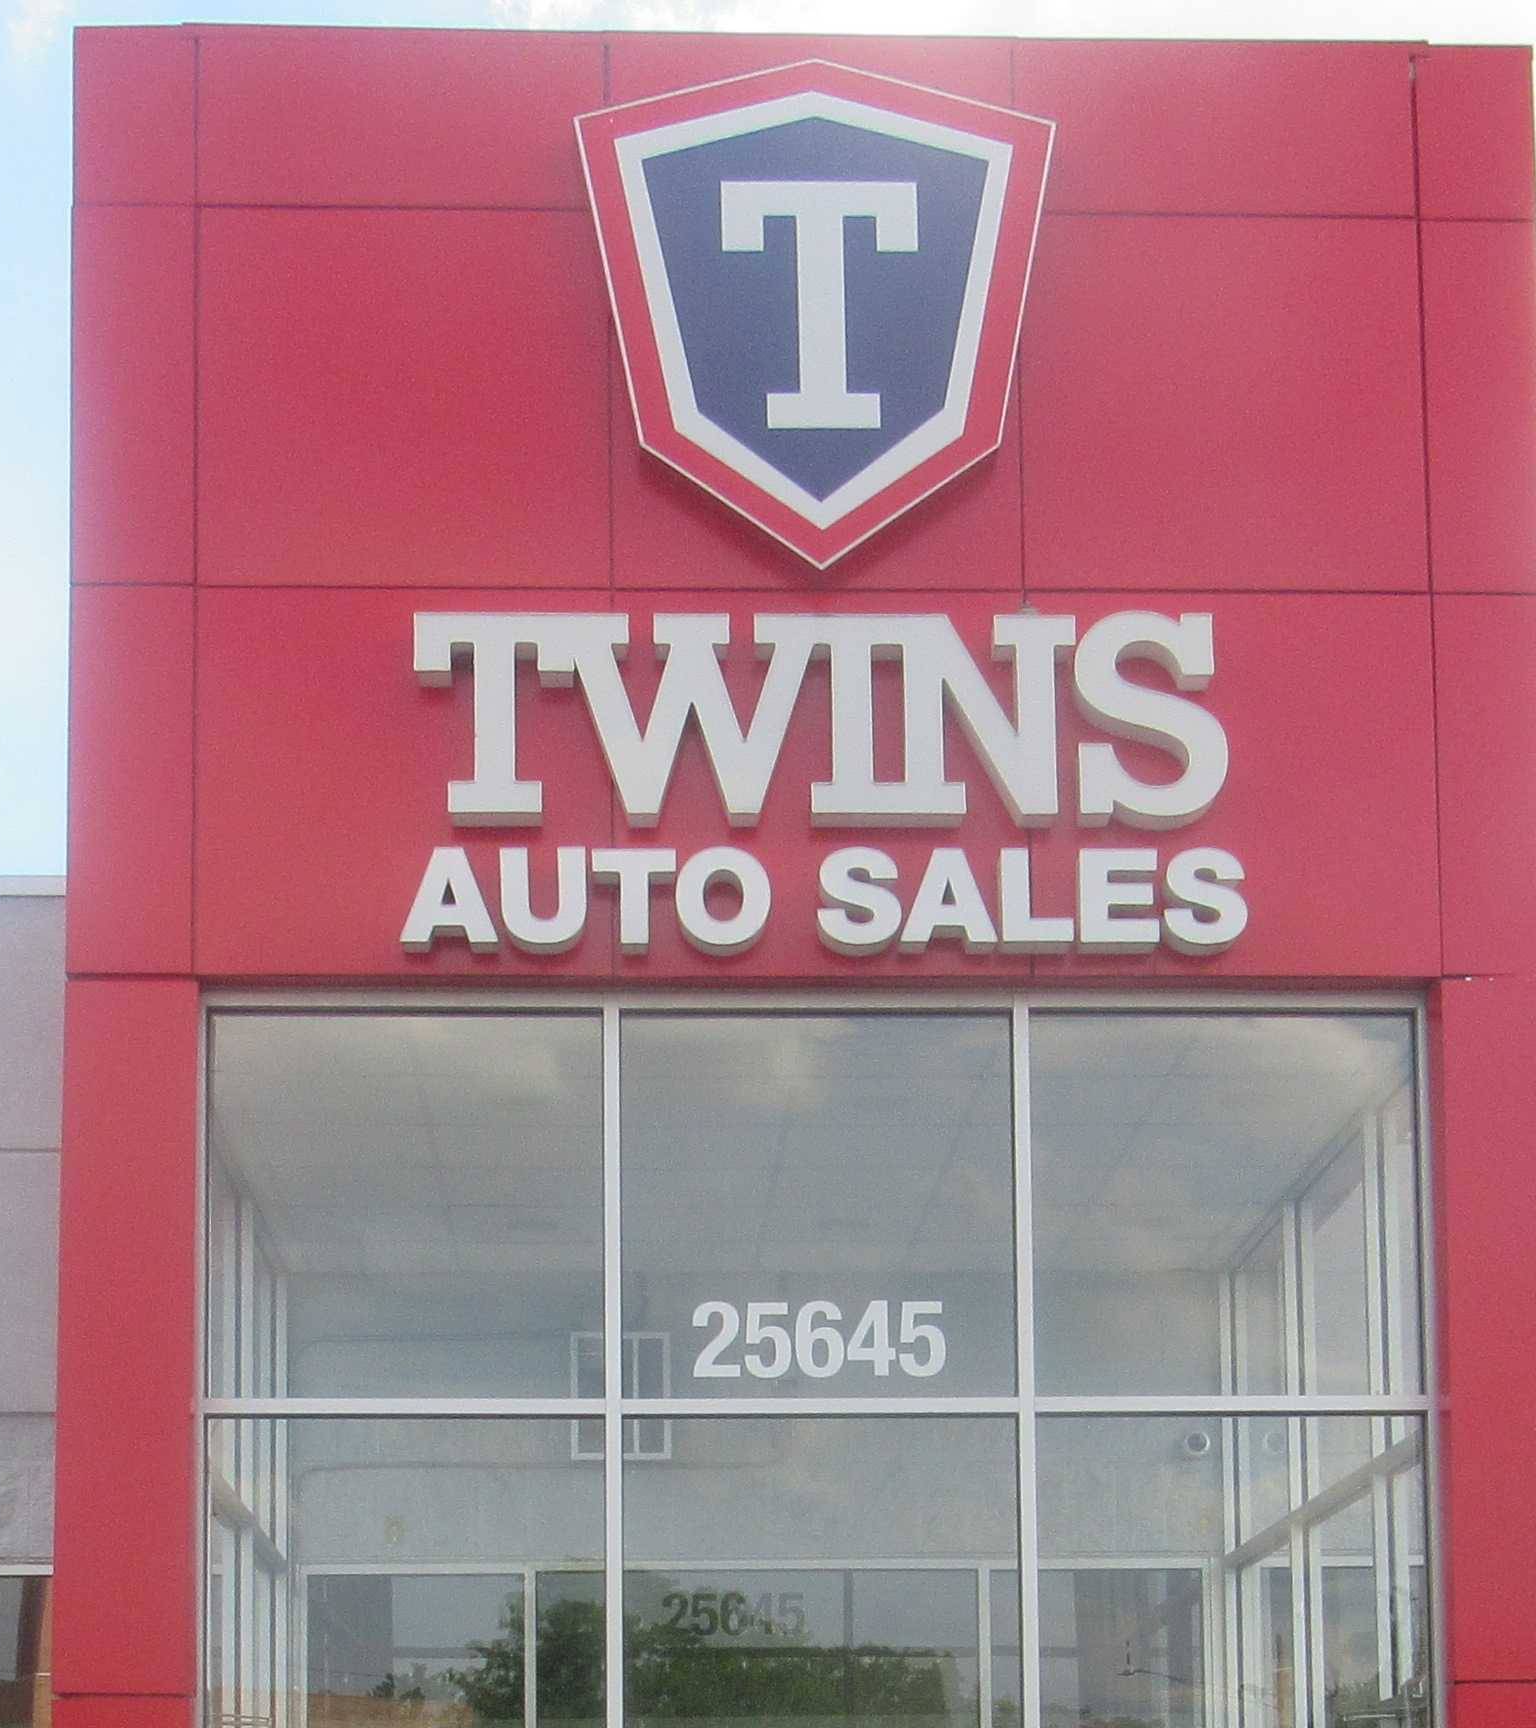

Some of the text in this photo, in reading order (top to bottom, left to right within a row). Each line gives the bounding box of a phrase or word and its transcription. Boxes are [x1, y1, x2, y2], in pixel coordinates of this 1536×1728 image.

[720, 180, 919, 430] T
[413, 609, 1230, 830] TWINS
[400, 845, 1248, 955] AUTO SALES
[691, 1299, 948, 1379] 25645
[661, 1592, 807, 1637] 25645
